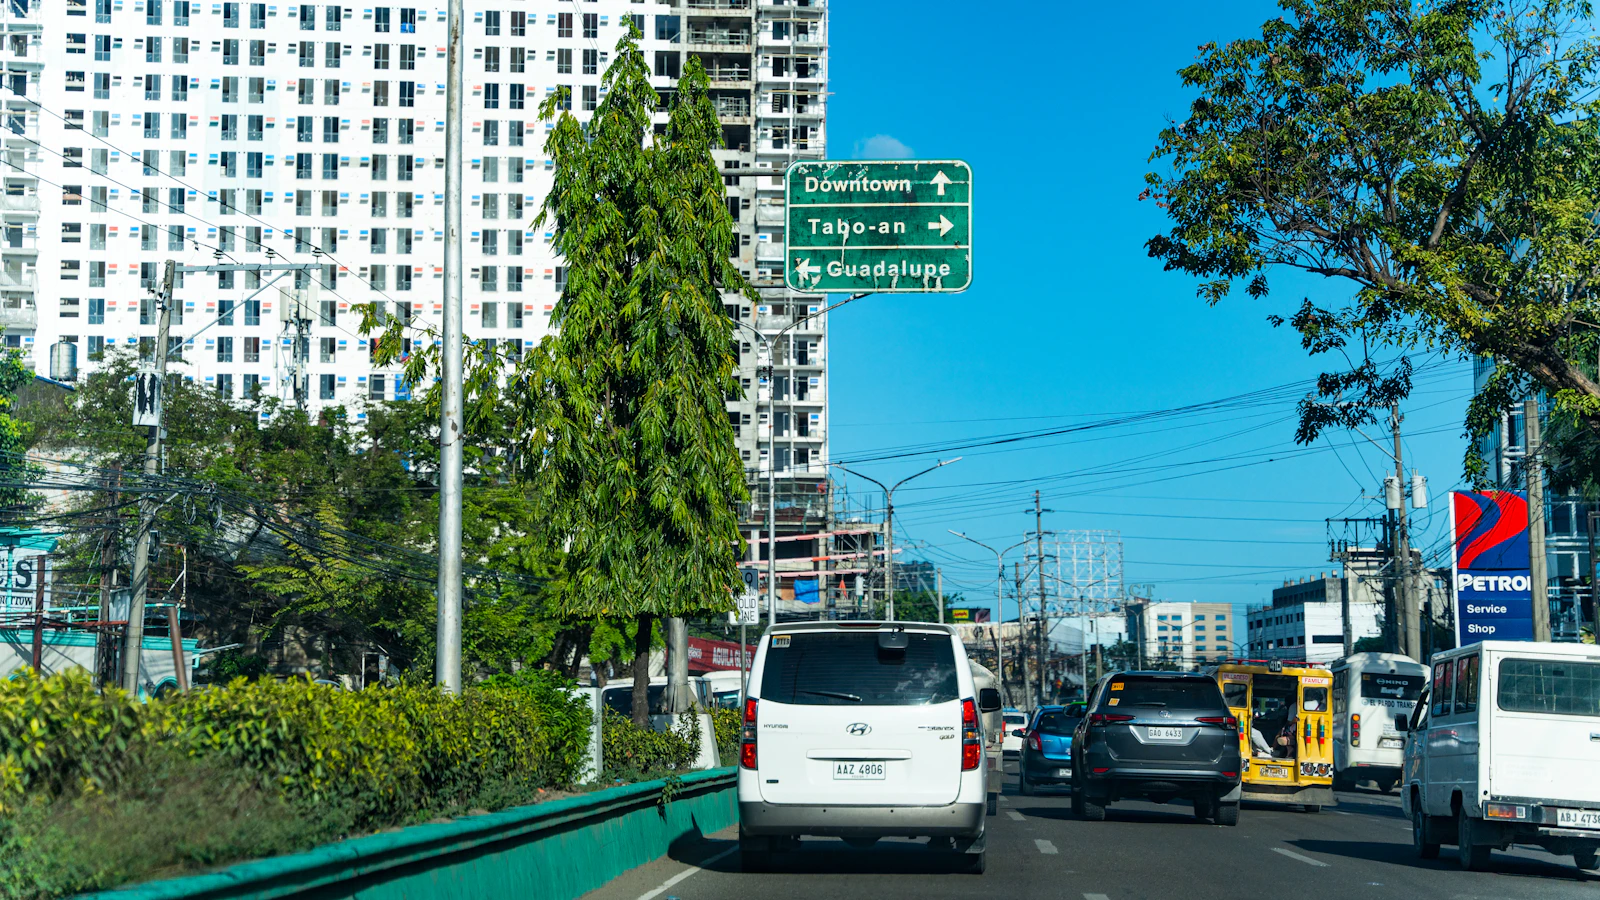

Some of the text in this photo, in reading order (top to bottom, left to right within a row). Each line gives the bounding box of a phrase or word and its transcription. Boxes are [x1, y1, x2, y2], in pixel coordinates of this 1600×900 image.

[804, 176, 911, 193] Downtown
[807, 218, 906, 235] Tabo-an
[826, 260, 951, 278] Guadalupe
[736, 598, 757, 609] OLID
[1466, 604, 1507, 614] Service
[1467, 623, 1496, 635] Shop
[712, 646, 734, 667] AGUILA
[735, 650, 752, 668] GLSS
[1369, 699, 1417, 709] EL PARDO TRANSP
[836, 764, 883, 775] AAZ 4806
[1560, 812, 1577, 823] ABJ
